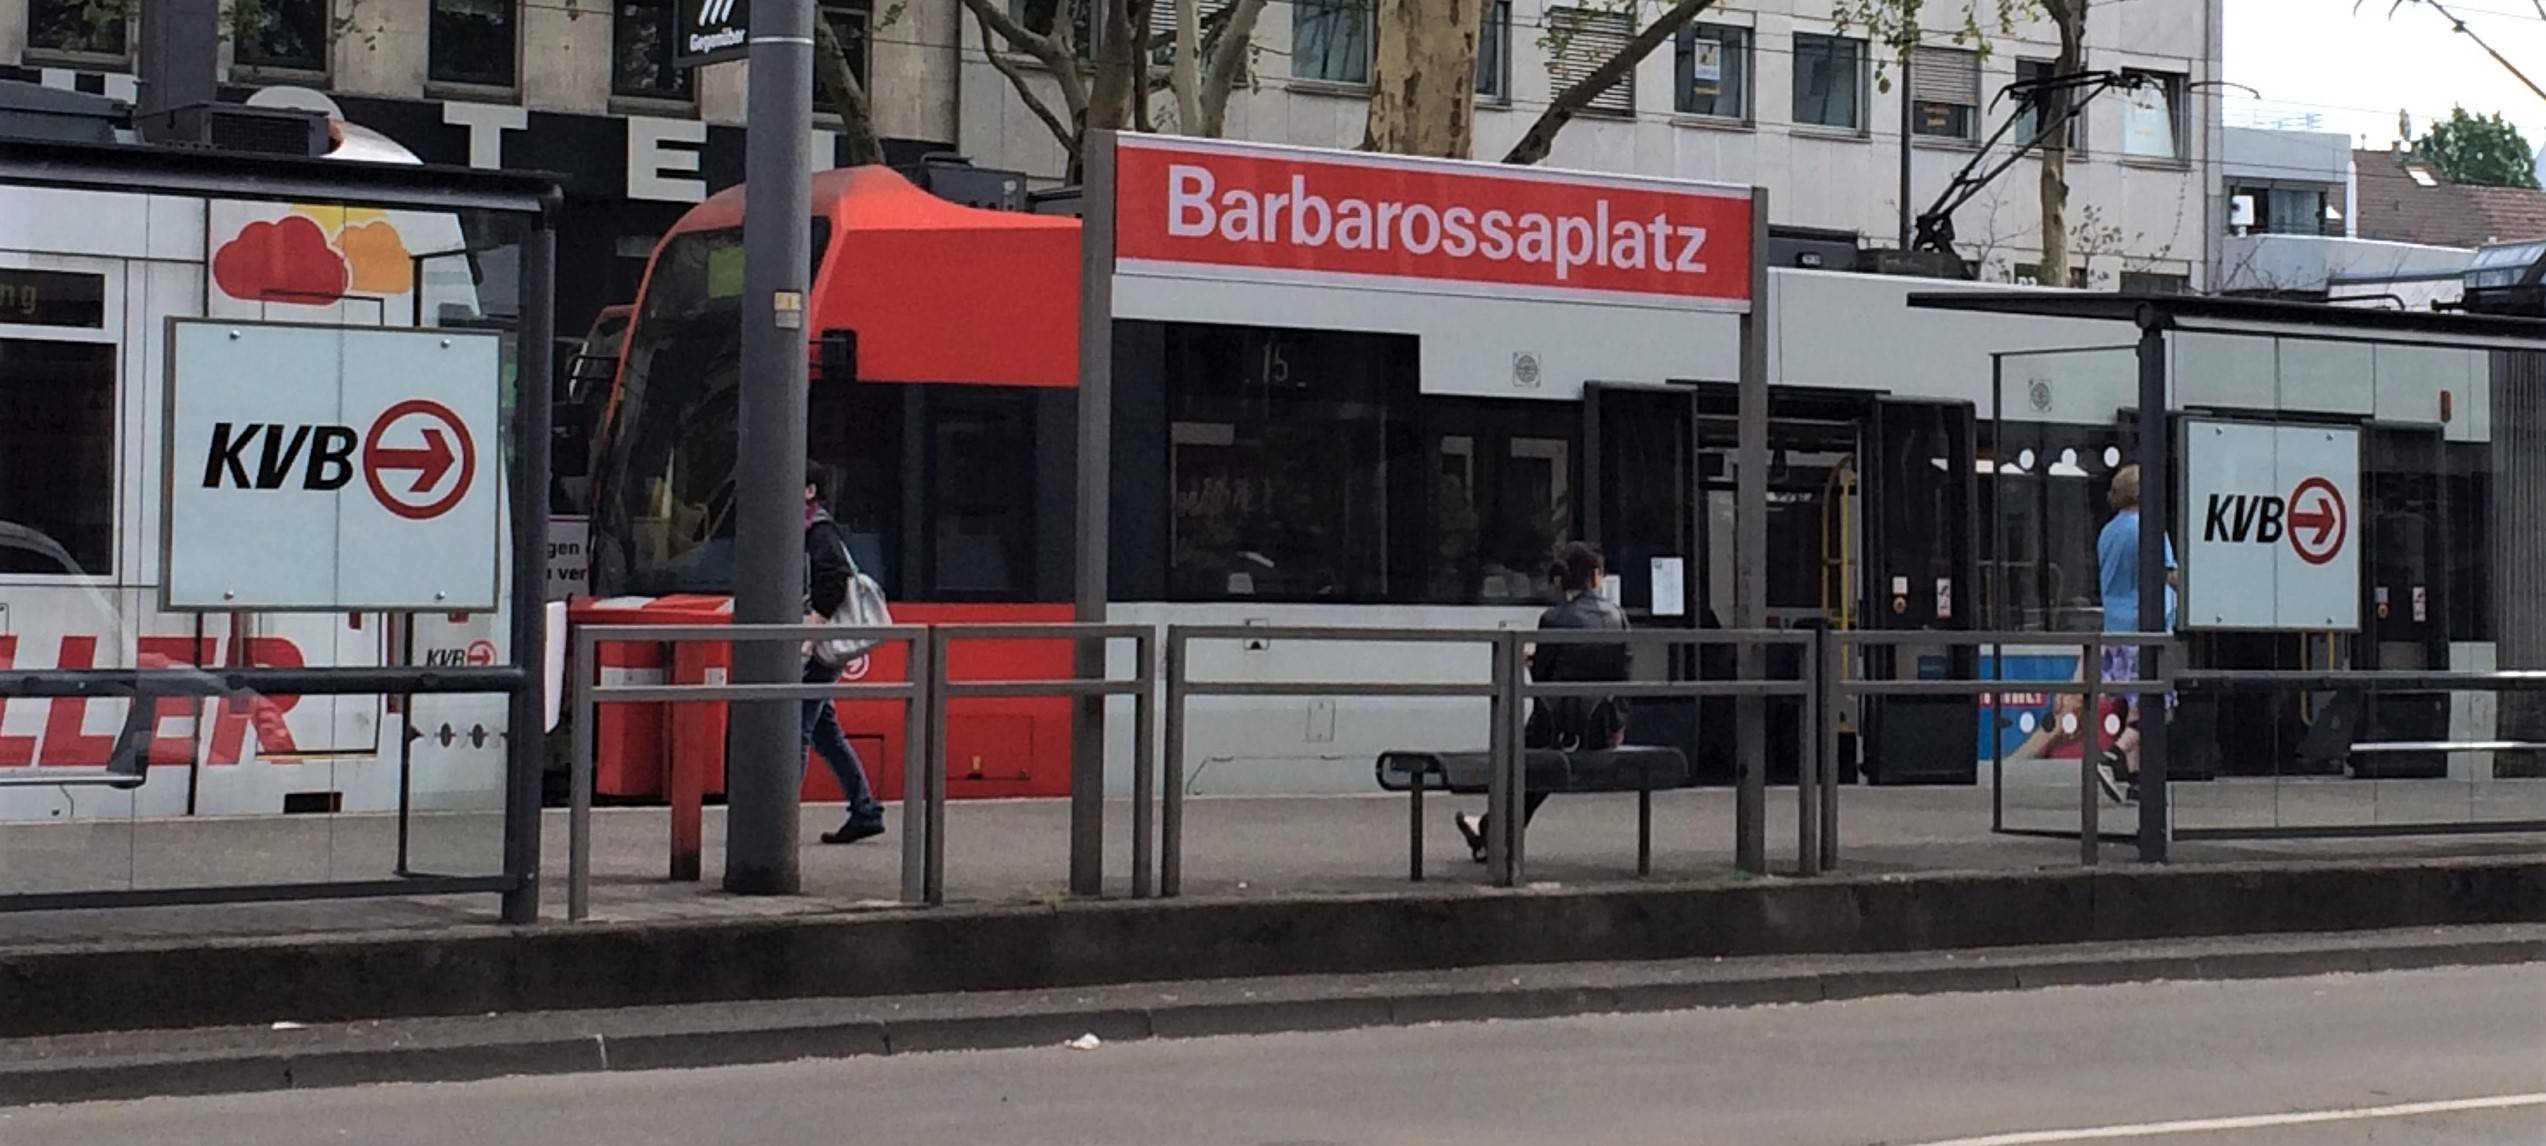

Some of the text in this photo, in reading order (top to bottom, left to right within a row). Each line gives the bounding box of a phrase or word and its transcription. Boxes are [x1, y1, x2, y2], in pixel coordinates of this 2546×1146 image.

[1167, 164, 1708, 279] Barbarossaplatz
[202, 421, 359, 490] KVB
[2203, 494, 2285, 543] KVB
